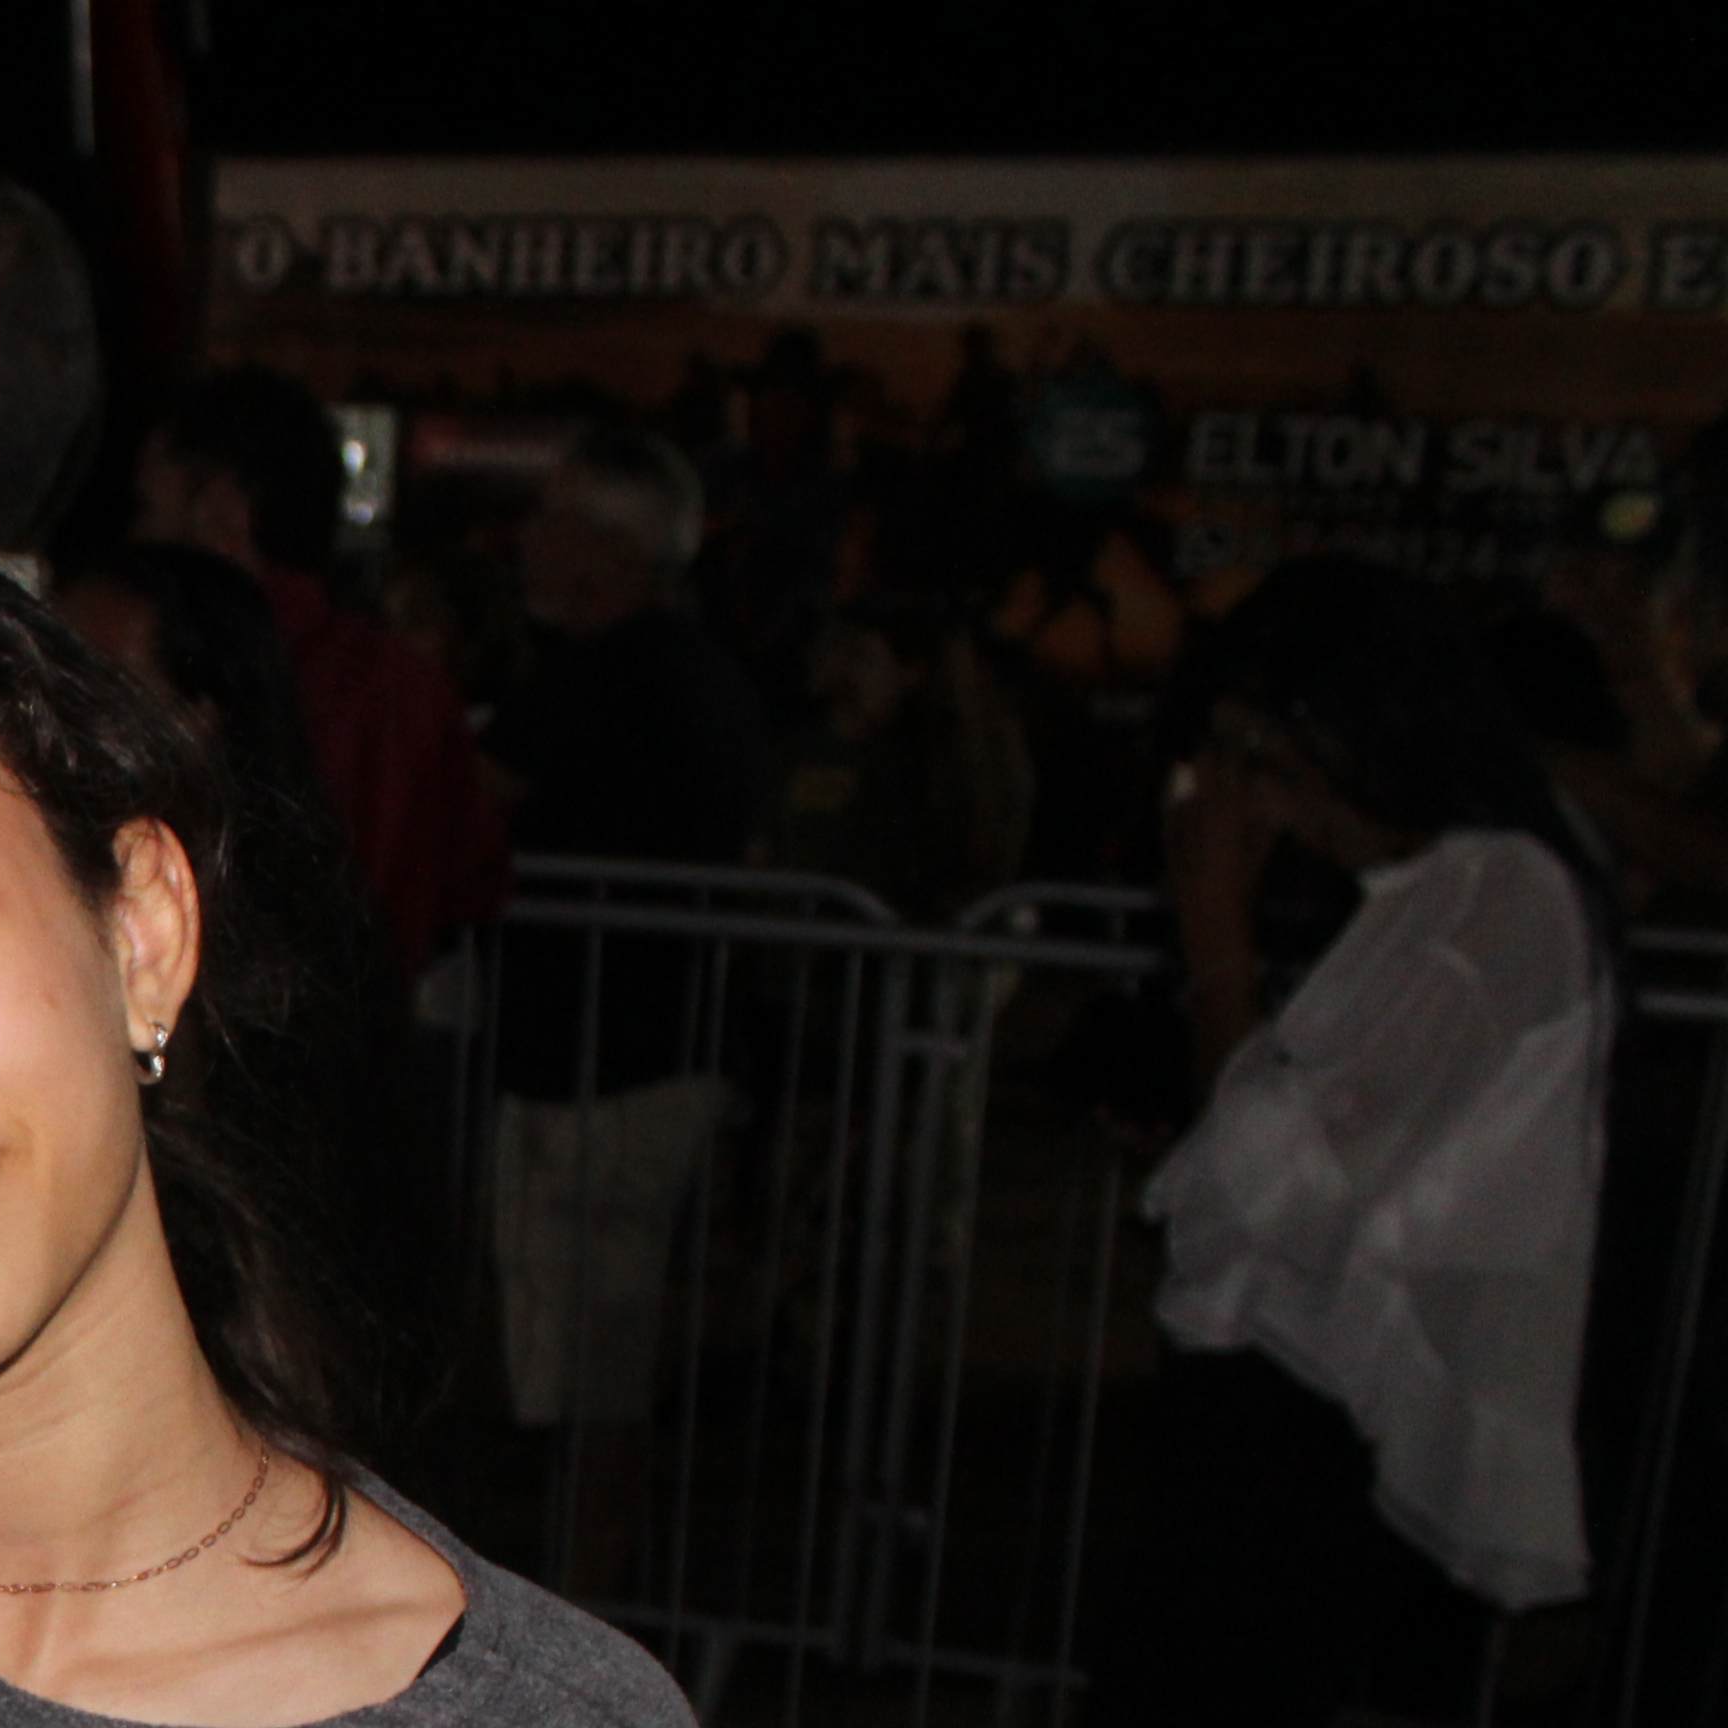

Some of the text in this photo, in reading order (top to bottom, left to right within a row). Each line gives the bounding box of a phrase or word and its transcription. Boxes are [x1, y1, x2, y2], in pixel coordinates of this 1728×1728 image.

[234, 217, 1728, 309] O BANHEIRO MAIS CHEIROSO E
[1185, 408, 1662, 496] ELTON SILVA
